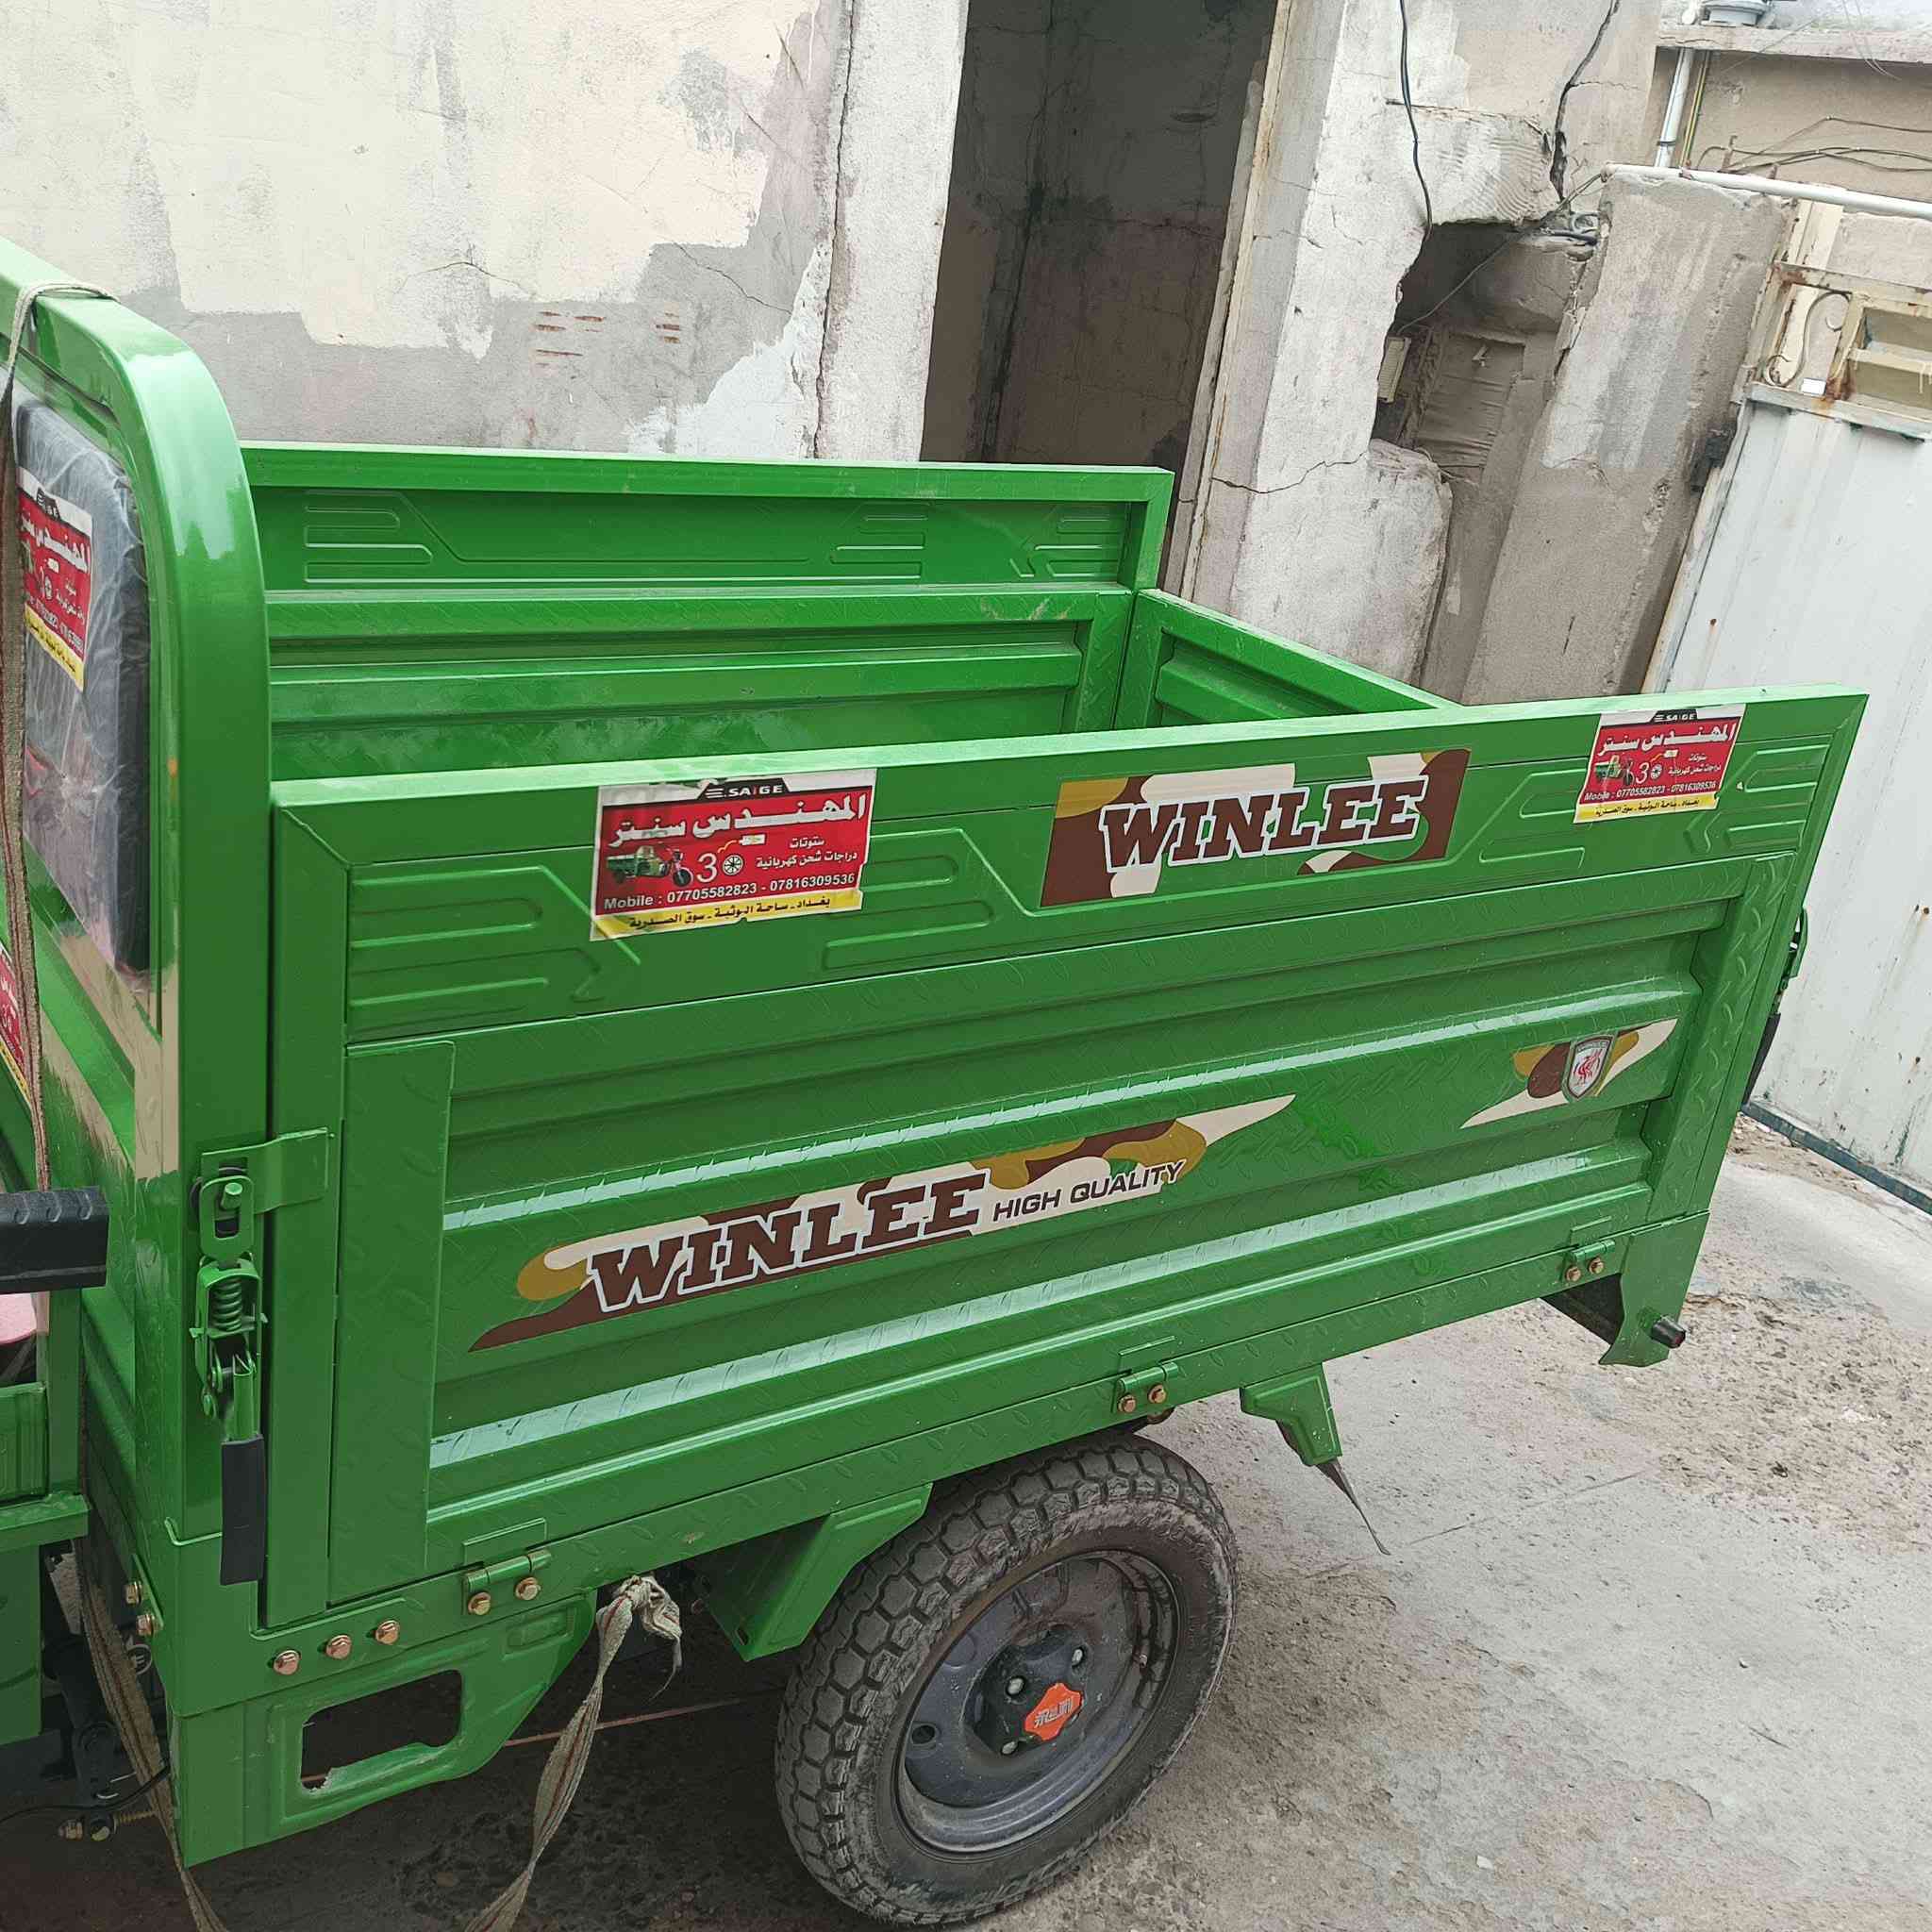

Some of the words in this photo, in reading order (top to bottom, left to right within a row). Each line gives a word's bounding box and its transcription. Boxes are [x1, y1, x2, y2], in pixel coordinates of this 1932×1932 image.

[1597, 735, 1640, 757] سنتر
[1641, 723, 1737, 752] المهندس
[727, 784, 784, 797] SAIGE
[692, 792, 867, 839] المهندس
[1100, 775, 1428, 873] WINLEE
[608, 817, 687, 847] سنتر
[824, 850, 858, 863] دراجات
[604, 894, 654, 909] Mobile
[666, 882, 758, 904] 07705582823
[770, 873, 856, 891] 07816309536
[589, 1170, 989, 1311] WINLEE
[993, 1189, 1061, 1222] HIGH
[1070, 1160, 1185, 1204] QUALITY
